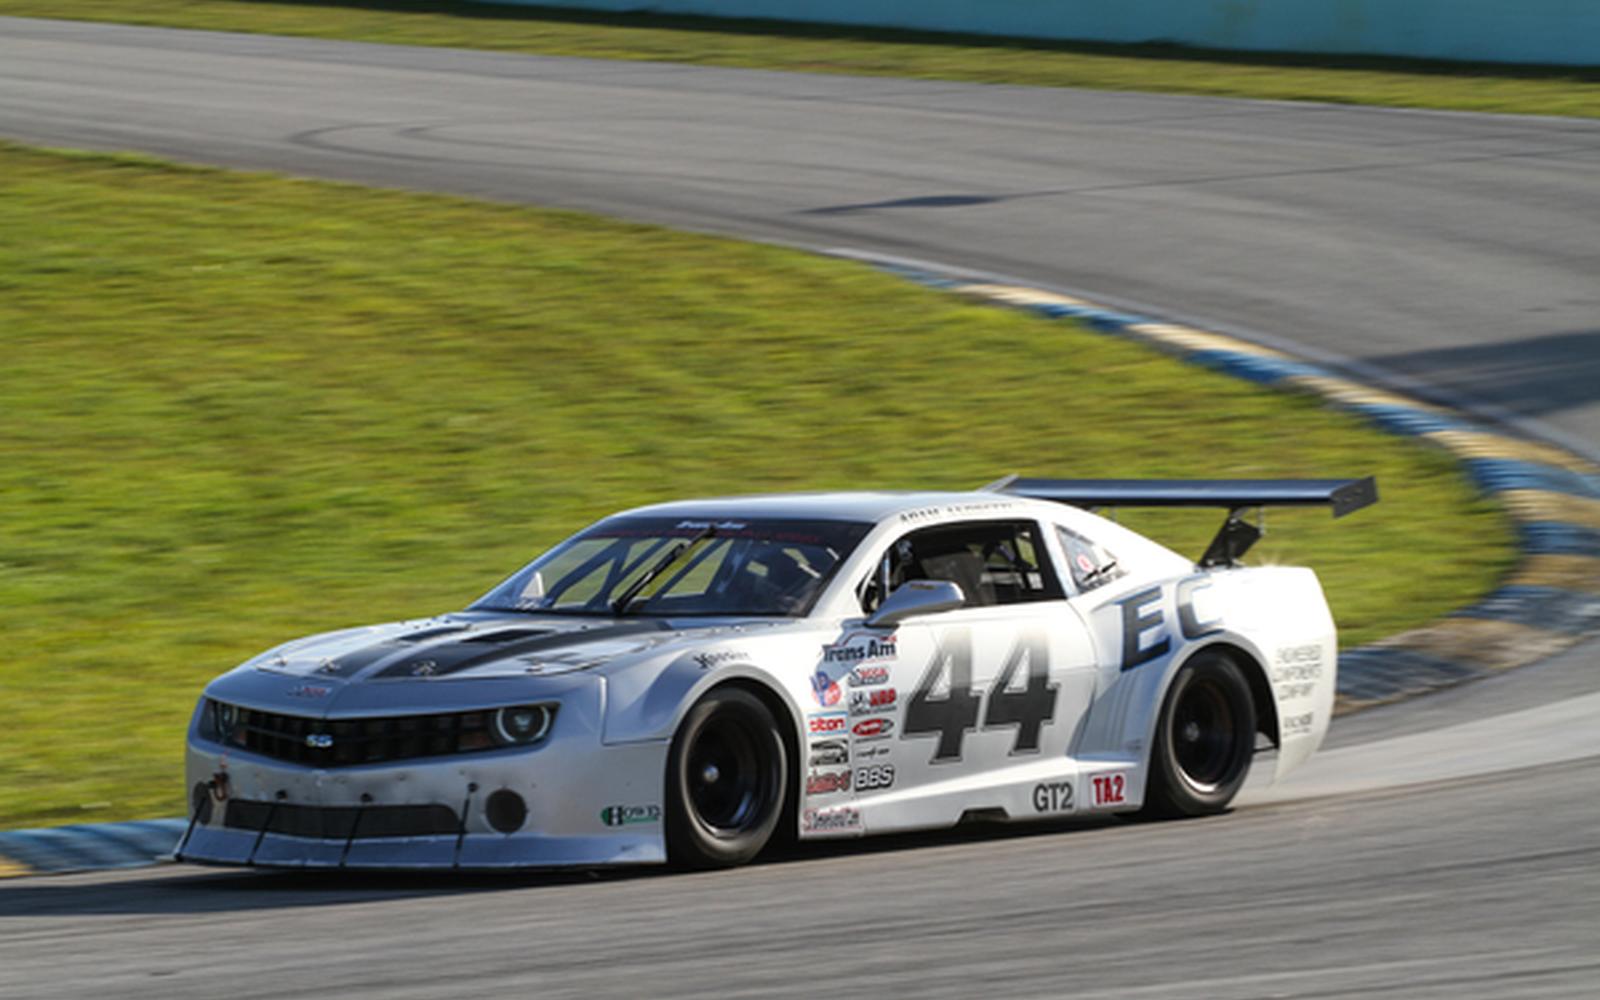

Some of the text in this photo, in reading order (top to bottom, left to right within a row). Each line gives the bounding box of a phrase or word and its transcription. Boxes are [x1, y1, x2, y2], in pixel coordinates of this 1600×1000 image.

[867, 640, 896, 657] Am
[900, 625, 1061, 765] 44
[856, 766, 895, 792] BBS
[1092, 775, 1124, 805] TA2
[1033, 782, 1073, 812] GT2
